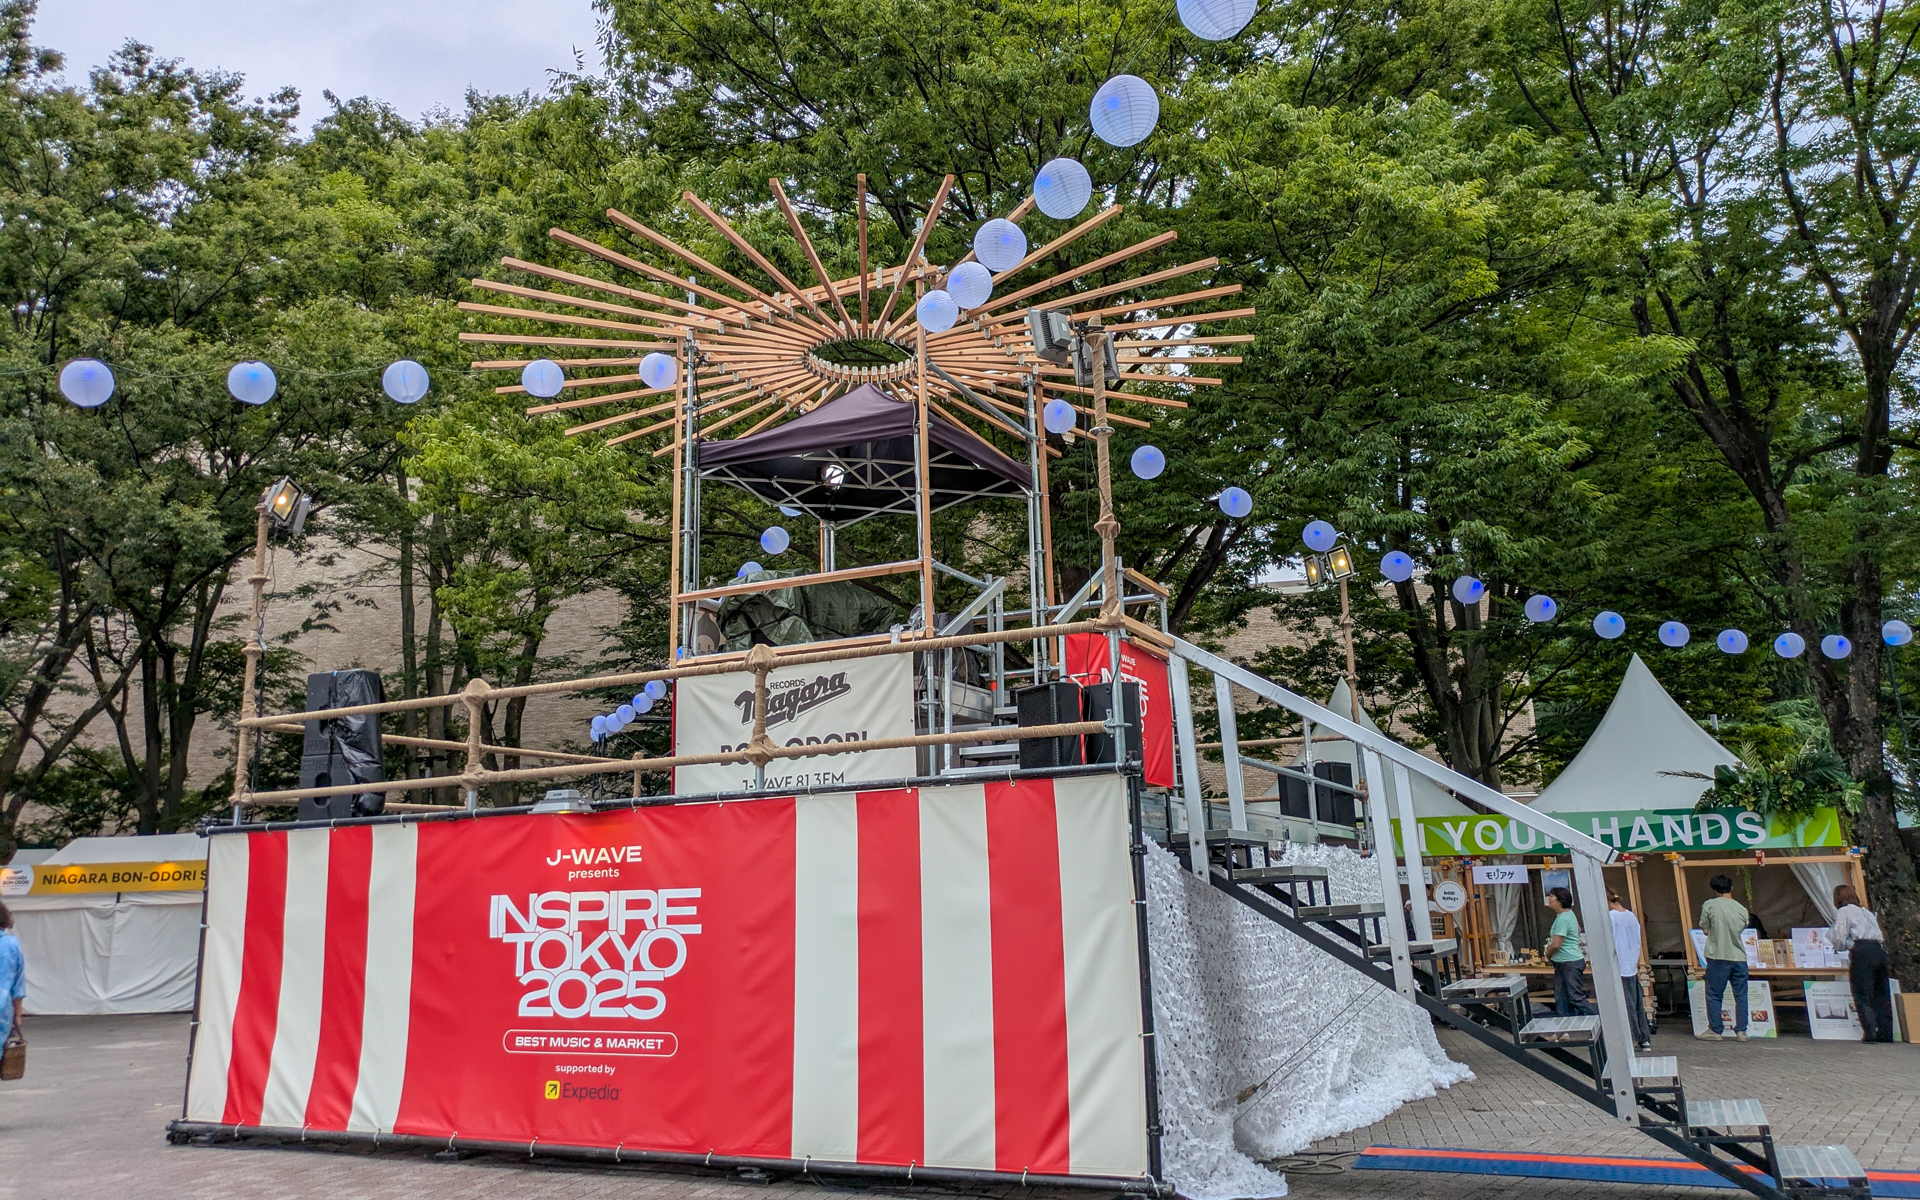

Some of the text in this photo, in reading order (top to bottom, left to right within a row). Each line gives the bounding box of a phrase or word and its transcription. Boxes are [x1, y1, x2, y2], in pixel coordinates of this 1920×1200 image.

[770, 678, 806, 690] RECORDS
[796, 770, 844, 788] 813FM
[1591, 811, 1768, 848] HANDS
[546, 845, 642, 866] J-WAVE
[42, 872, 108, 885] NIAGARA
[111, 869, 196, 883] BON-ODORI
[568, 867, 620, 881] presents
[1485, 868, 1515, 880] モリアゲ
[490, 887, 702, 938] INSPIRE
[502, 927, 687, 978] TOKYO
[518, 969, 666, 1020] 2025
[515, 1036, 664, 1050] BEST MUSIC & MARKET
[555, 1063, 616, 1076] supported by
[562, 1082, 619, 1102] Expedia
